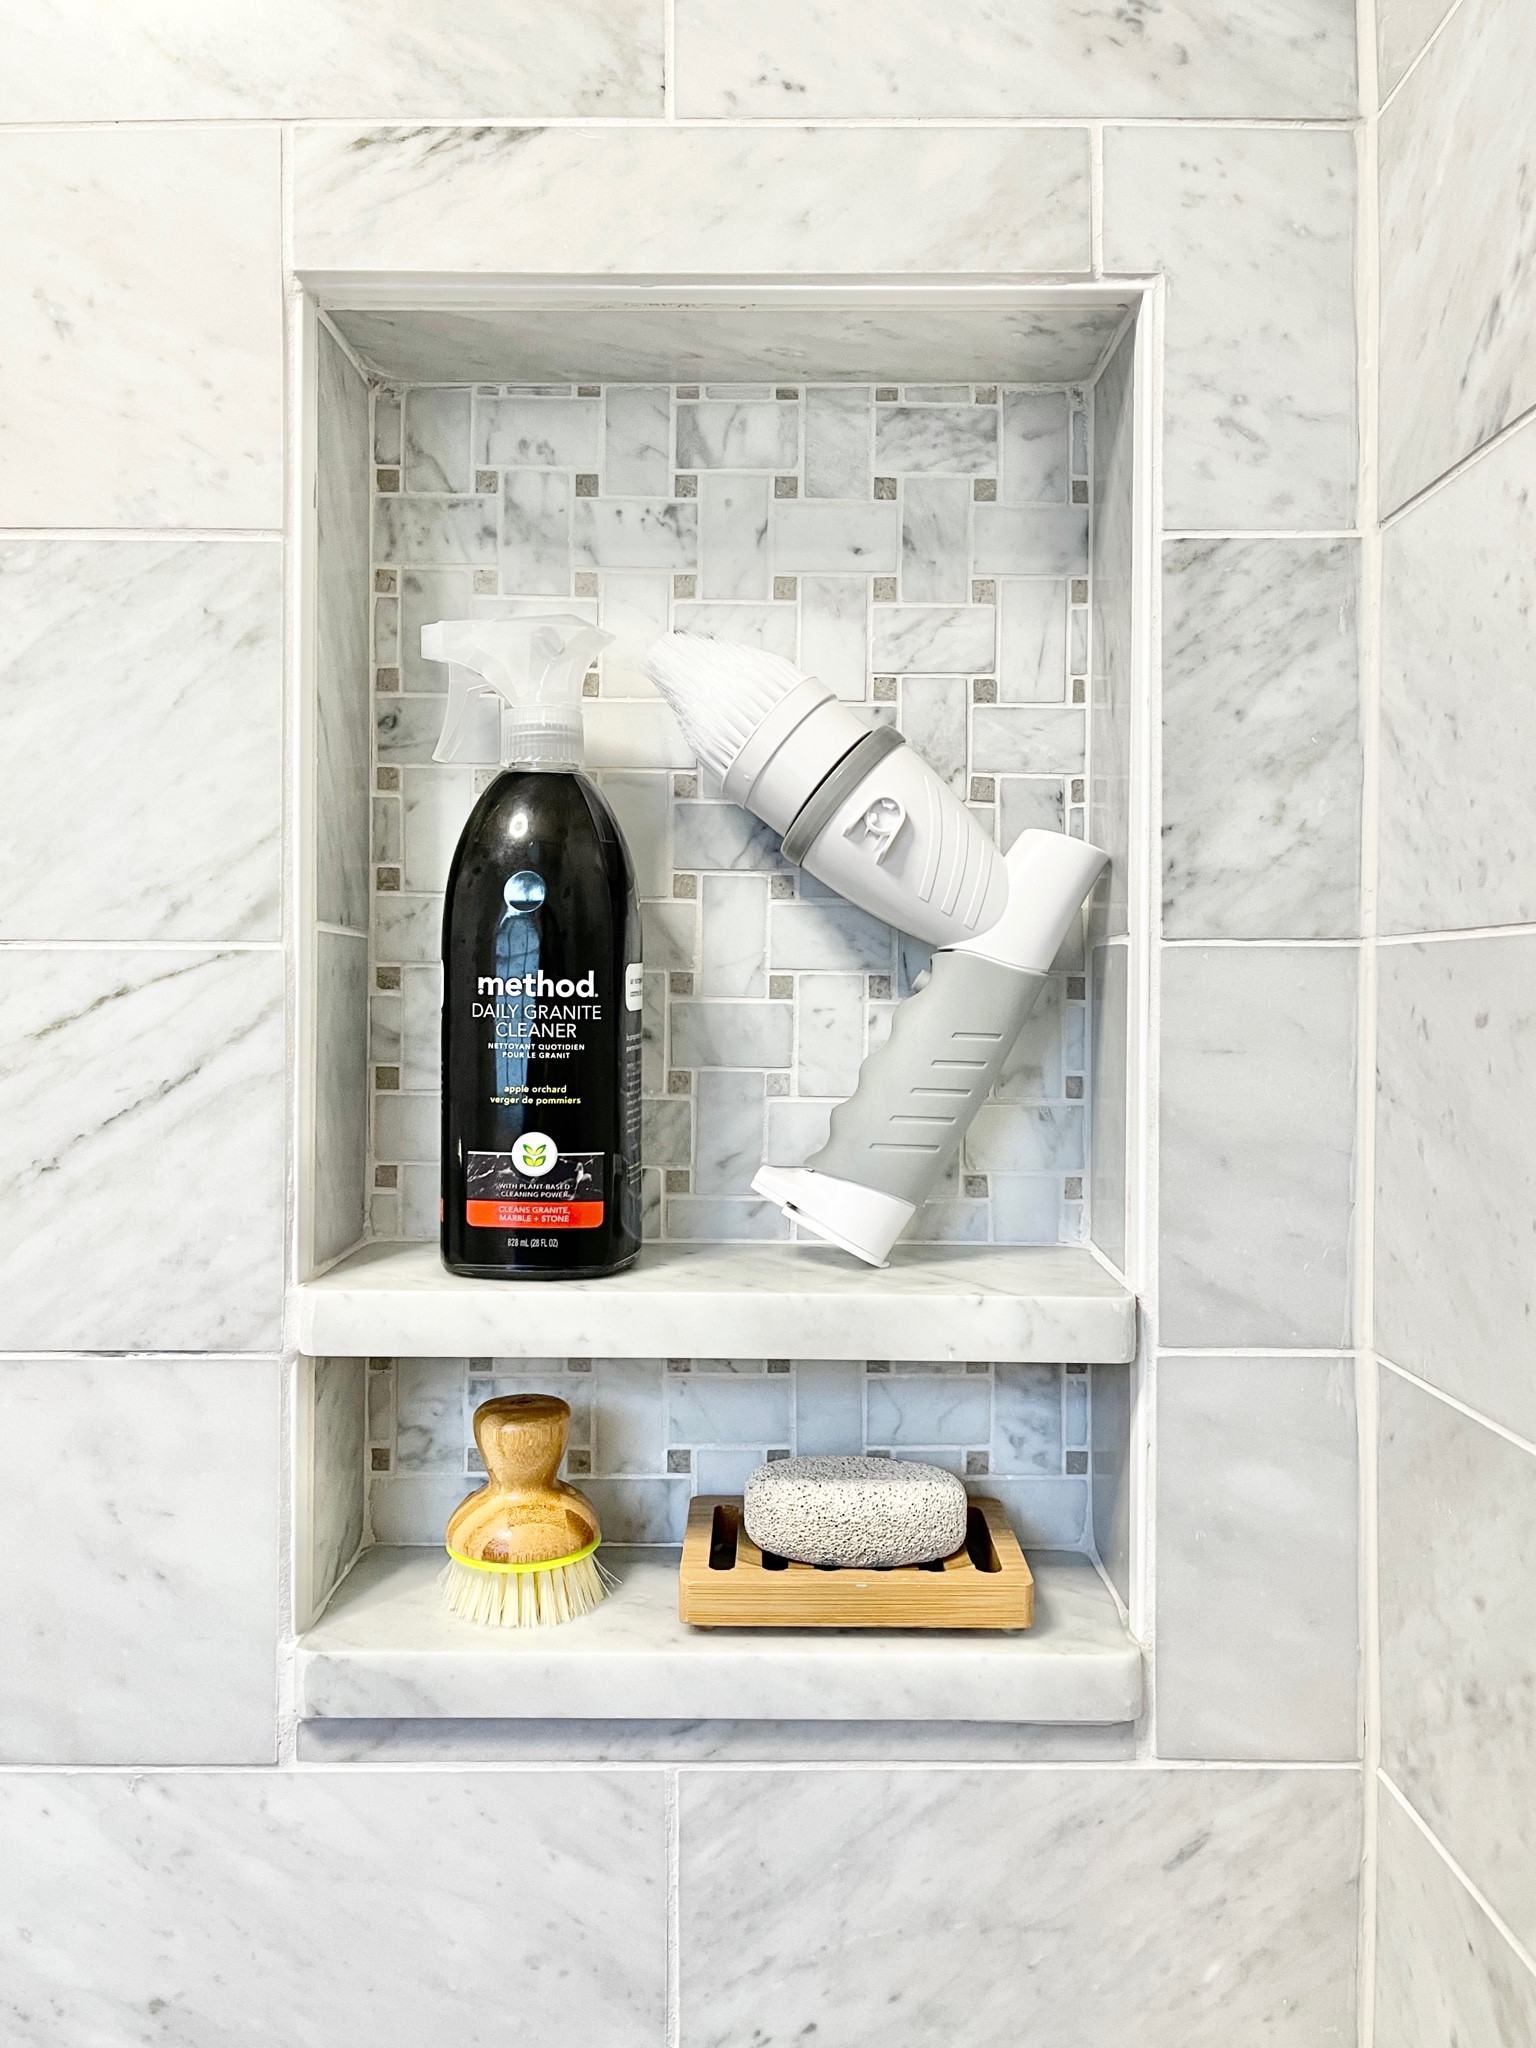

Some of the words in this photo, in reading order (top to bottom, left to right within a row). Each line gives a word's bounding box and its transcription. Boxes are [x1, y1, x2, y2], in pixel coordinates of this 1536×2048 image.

[478, 969, 599, 998] method.
[472, 1003, 519, 1019] DAILY
[524, 1004, 602, 1020] GRANITE
[495, 1022, 577, 1038] CLEANER
[487, 1042, 536, 1050] NETTOYANT
[538, 1043, 585, 1051] QUOTIDIEN
[502, 1051, 524, 1059] POUR
[527, 1051, 536, 1059] LE
[504, 1085, 529, 1094] apple
[532, 1084, 567, 1093] orchard
[490, 1096, 519, 1105] verger
[521, 1096, 533, 1104] de
[536, 1096, 582, 1106] pommiers
[498, 1205, 530, 1213] CLEANS
[532, 1206, 570, 1215] GRANITE,
[499, 1214, 532, 1222] MARBLE
[541, 1214, 570, 1223] STONE
[507, 1238, 519, 1247] 828
[519, 1239, 530, 1247] mL
[530, 1238, 540, 1248] (28
[541, 1239, 548, 1247] FL
